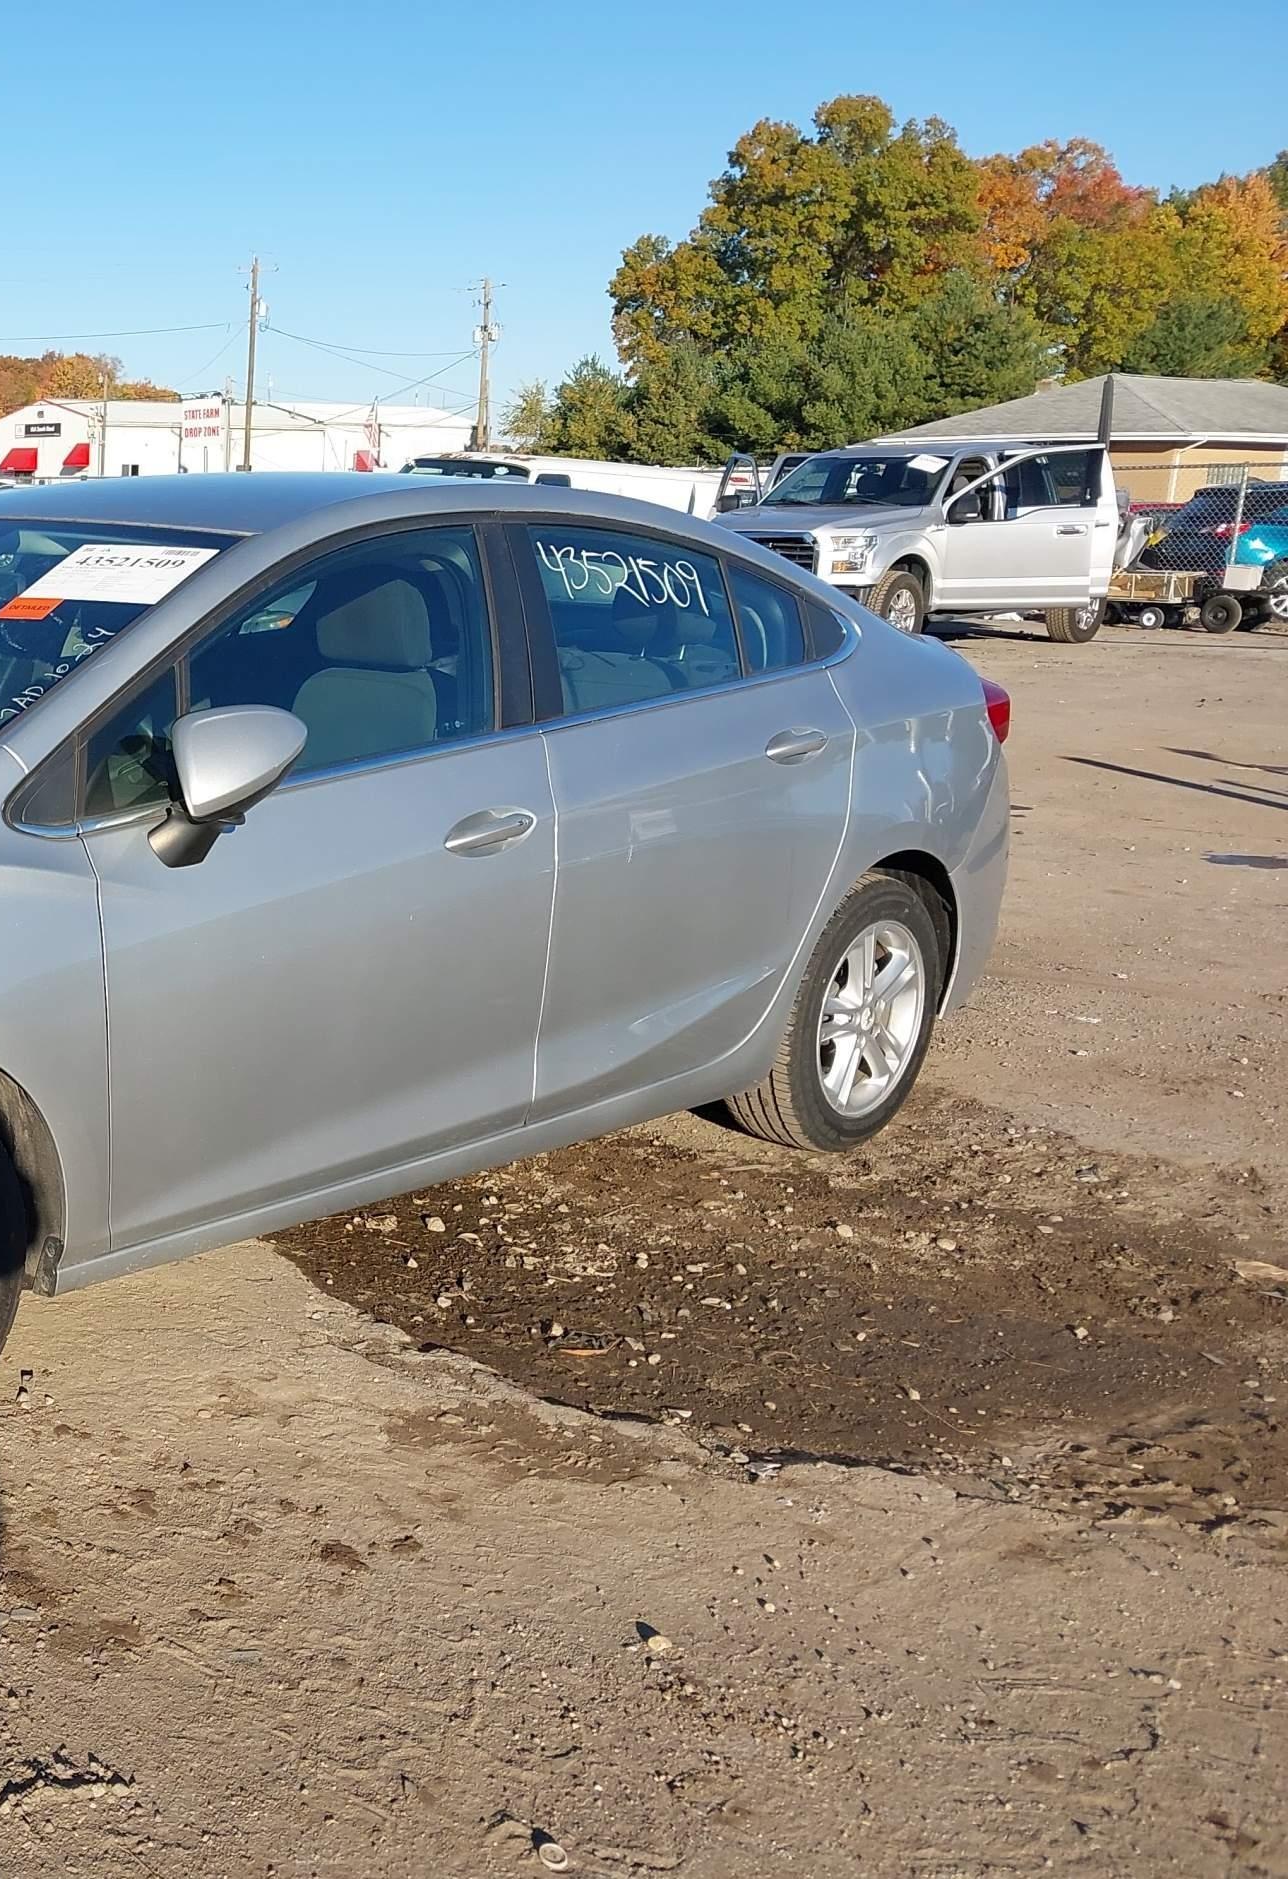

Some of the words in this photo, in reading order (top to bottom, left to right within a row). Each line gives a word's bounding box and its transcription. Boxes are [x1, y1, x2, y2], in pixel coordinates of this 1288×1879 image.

[184, 409, 202, 420] STATE
[203, 408, 220, 419] FARM
[184, 427, 202, 438] DROP
[204, 426, 220, 437] ZONE
[75, 555, 186, 569] 43521509
[536, 541, 710, 617] 43521509
